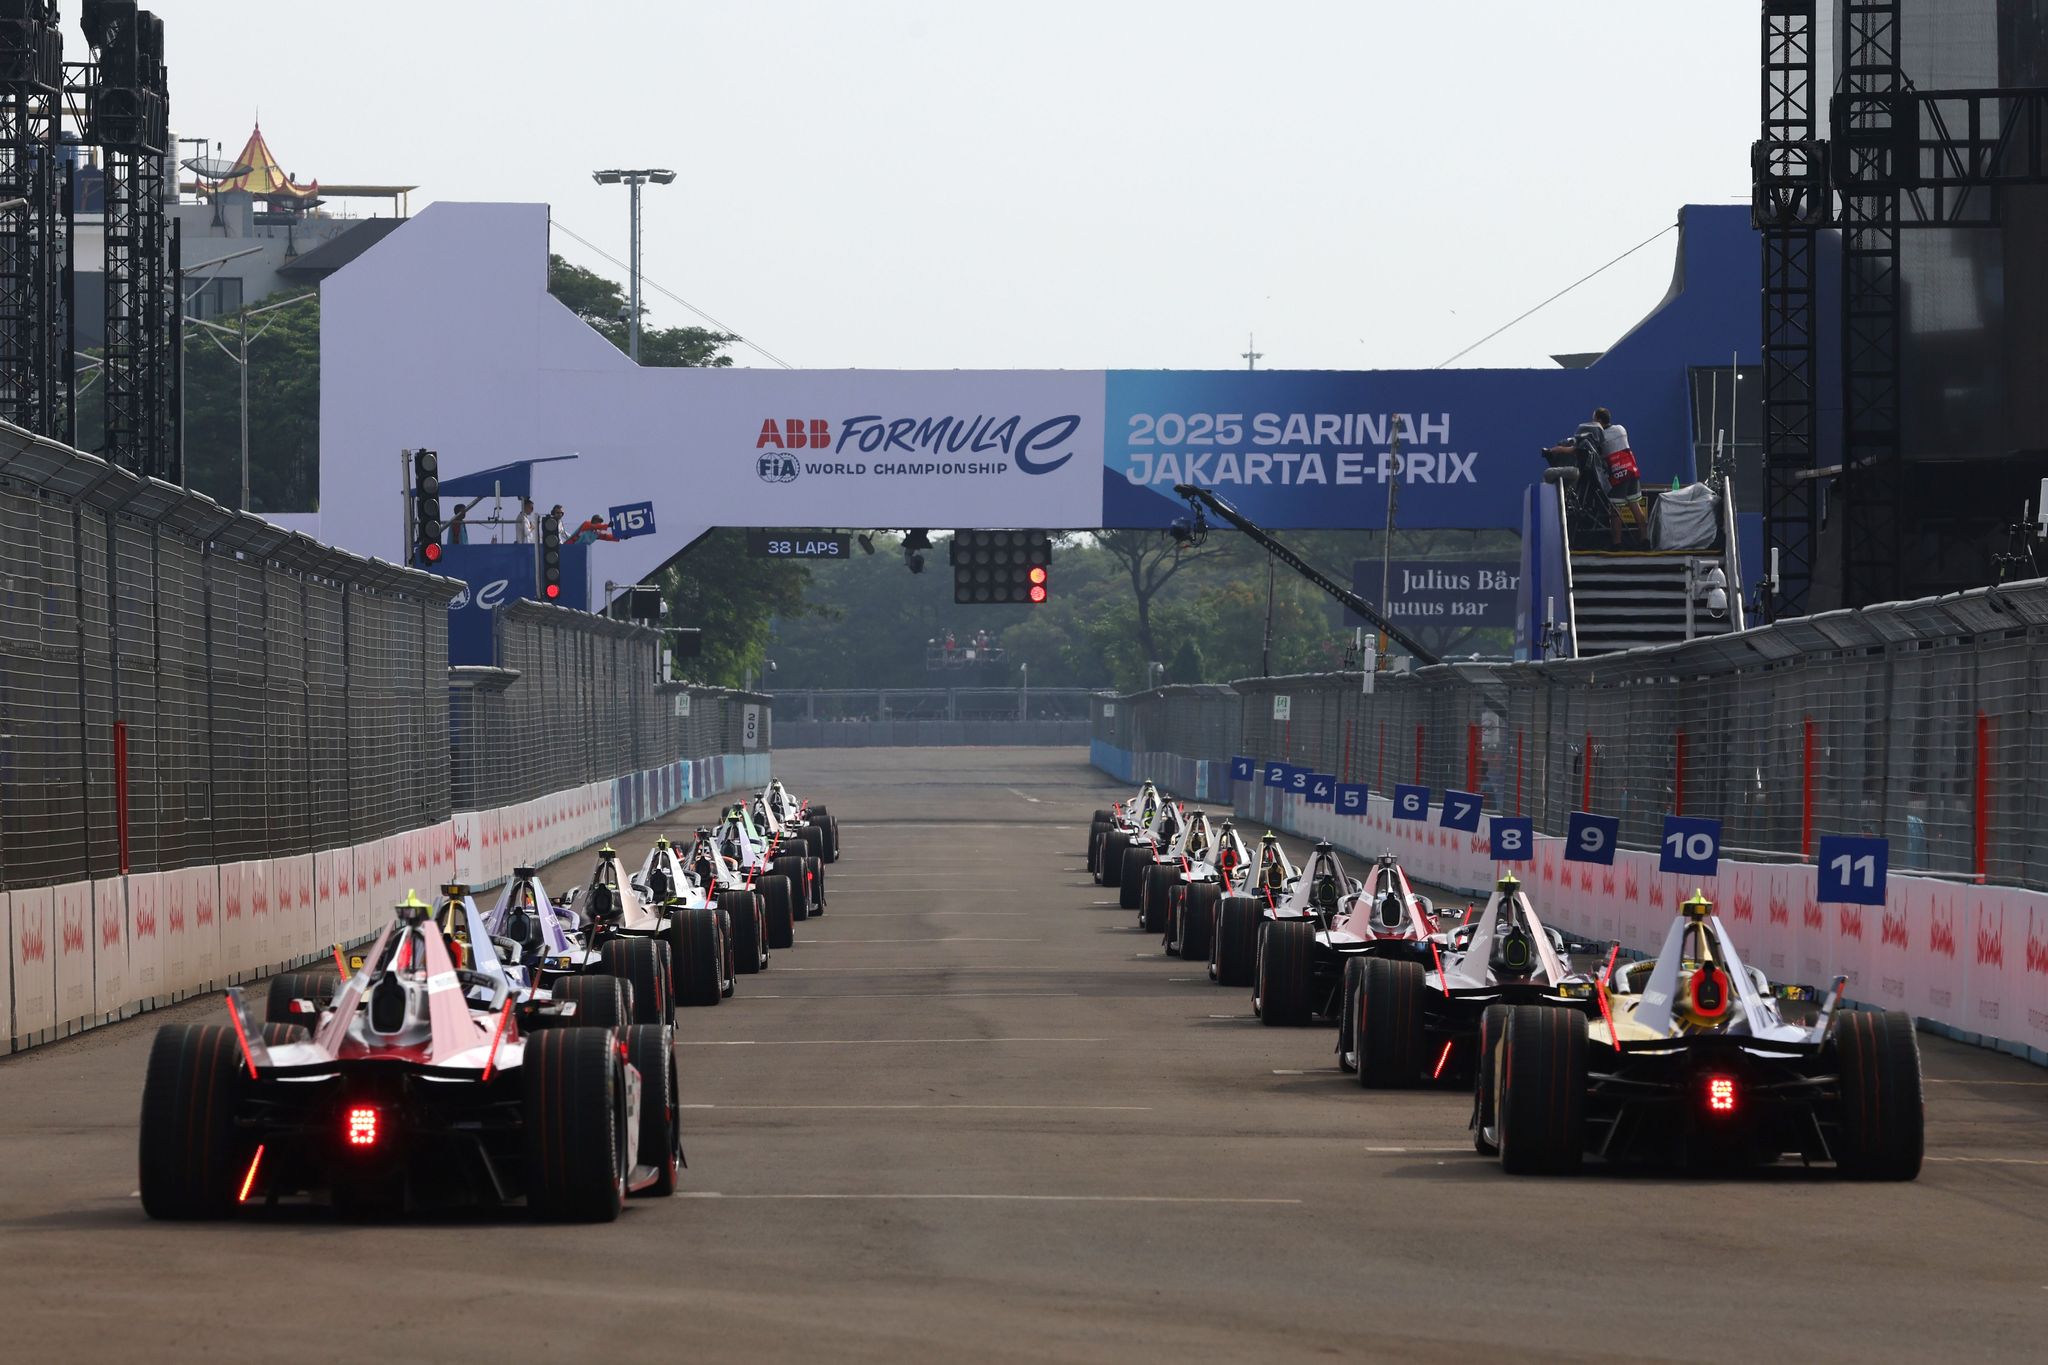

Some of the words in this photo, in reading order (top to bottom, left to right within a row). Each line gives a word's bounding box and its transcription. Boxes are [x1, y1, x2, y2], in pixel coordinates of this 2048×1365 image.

[756, 418, 832, 449] ABB
[835, 414, 1021, 455] FORMULA
[1127, 413, 1243, 446] 2025
[1252, 412, 1450, 446] SARINAH
[805, 463, 866, 475] WORLD
[873, 463, 1008, 475] CHAMPIONSHIP
[1126, 452, 1328, 486] JAKARTA
[1336, 452, 1479, 485] E-PRIX
[768, 541, 791, 554] 38
[795, 541, 839, 555] LAPS
[1402, 569, 1471, 594] Julius
[1477, 569, 1521, 591] Bär
[1238, 763, 1247, 775] 1
[1271, 768, 1284, 782] 2
[1293, 773, 1306, 788] 3
[1313, 782, 1328, 797] 4
[1344, 791, 1360, 808] 5
[1403, 794, 1420, 812] 6
[1453, 802, 1471, 821] 7
[1501, 828, 1522, 850] 8
[1580, 826, 1604, 851] 9
[1666, 832, 1714, 862] 10
[1830, 854, 1875, 888] 11
